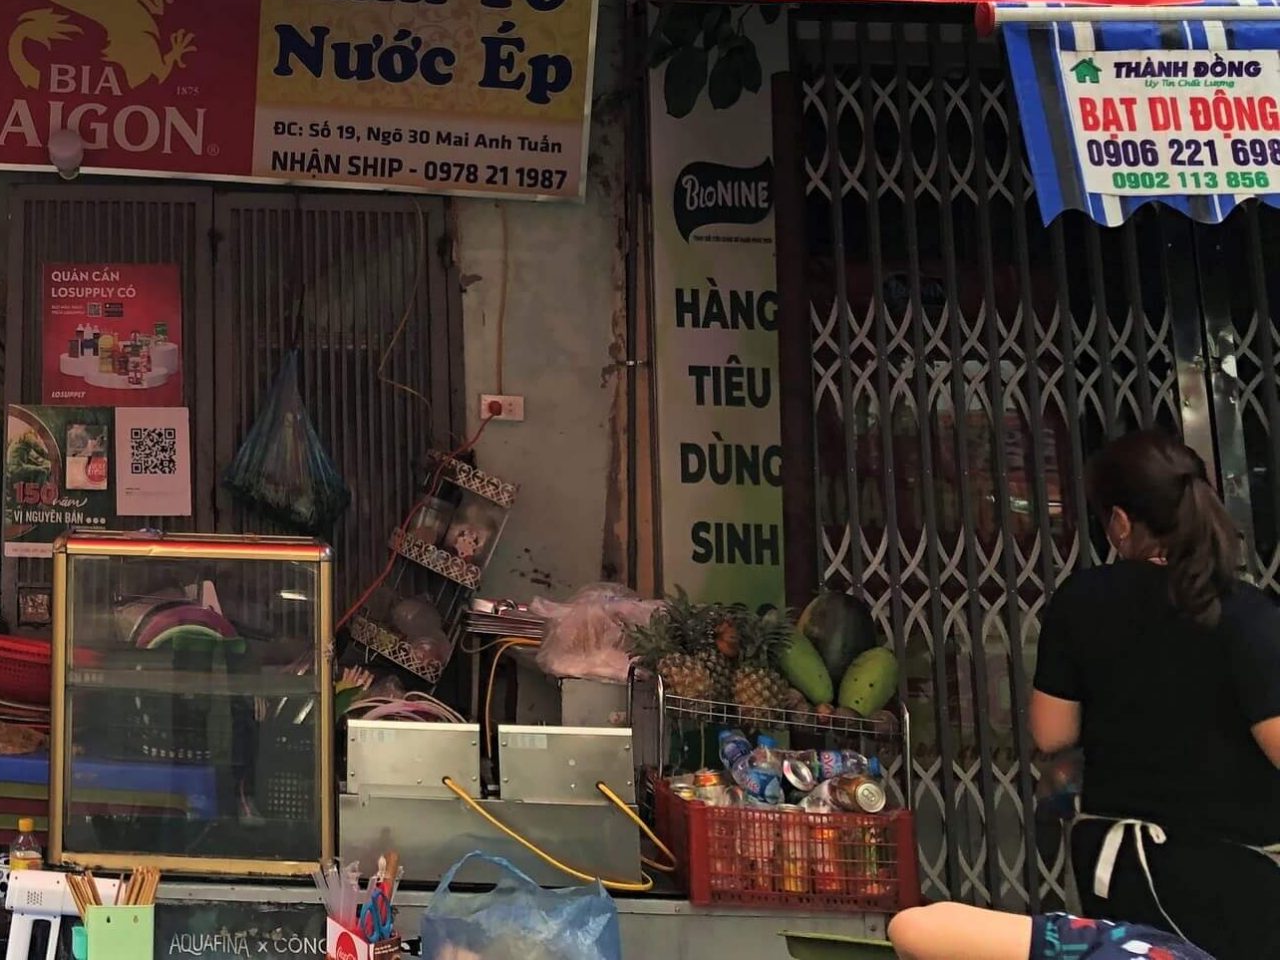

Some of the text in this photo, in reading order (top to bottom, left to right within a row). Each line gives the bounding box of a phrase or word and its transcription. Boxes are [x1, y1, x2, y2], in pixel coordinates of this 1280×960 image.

[272, 20, 573, 105] Nước Ép
[1113, 56, 1188, 78] THÀNH
[49, 63, 124, 96] BIA
[1079, 88, 1280, 140] BẠT DI ĐỘNG
[273, 120, 563, 154] ĐC: Số 19, Ngõ 30 Mai Anh Tuấn
[1086, 139, 1280, 168] 0906 221 698
[271, 148, 341, 180] NHẬN
[347, 155, 404, 179] SHIP
[423, 160, 480, 185] 0978
[485, 164, 509, 186] 21
[515, 167, 569, 190] 1987
[1112, 170, 1271, 189] 0902 113 856
[51, 283, 137, 299] LOSUPPLY CÓ
[675, 277, 780, 330] HÀNG
[688, 355, 772, 409] TIÊU
[13, 481, 59, 506] 150
[25, 508, 62, 524] NGUYÊN
[691, 521, 780, 566] SINH
[169, 933, 251, 958] AQUAFINA
